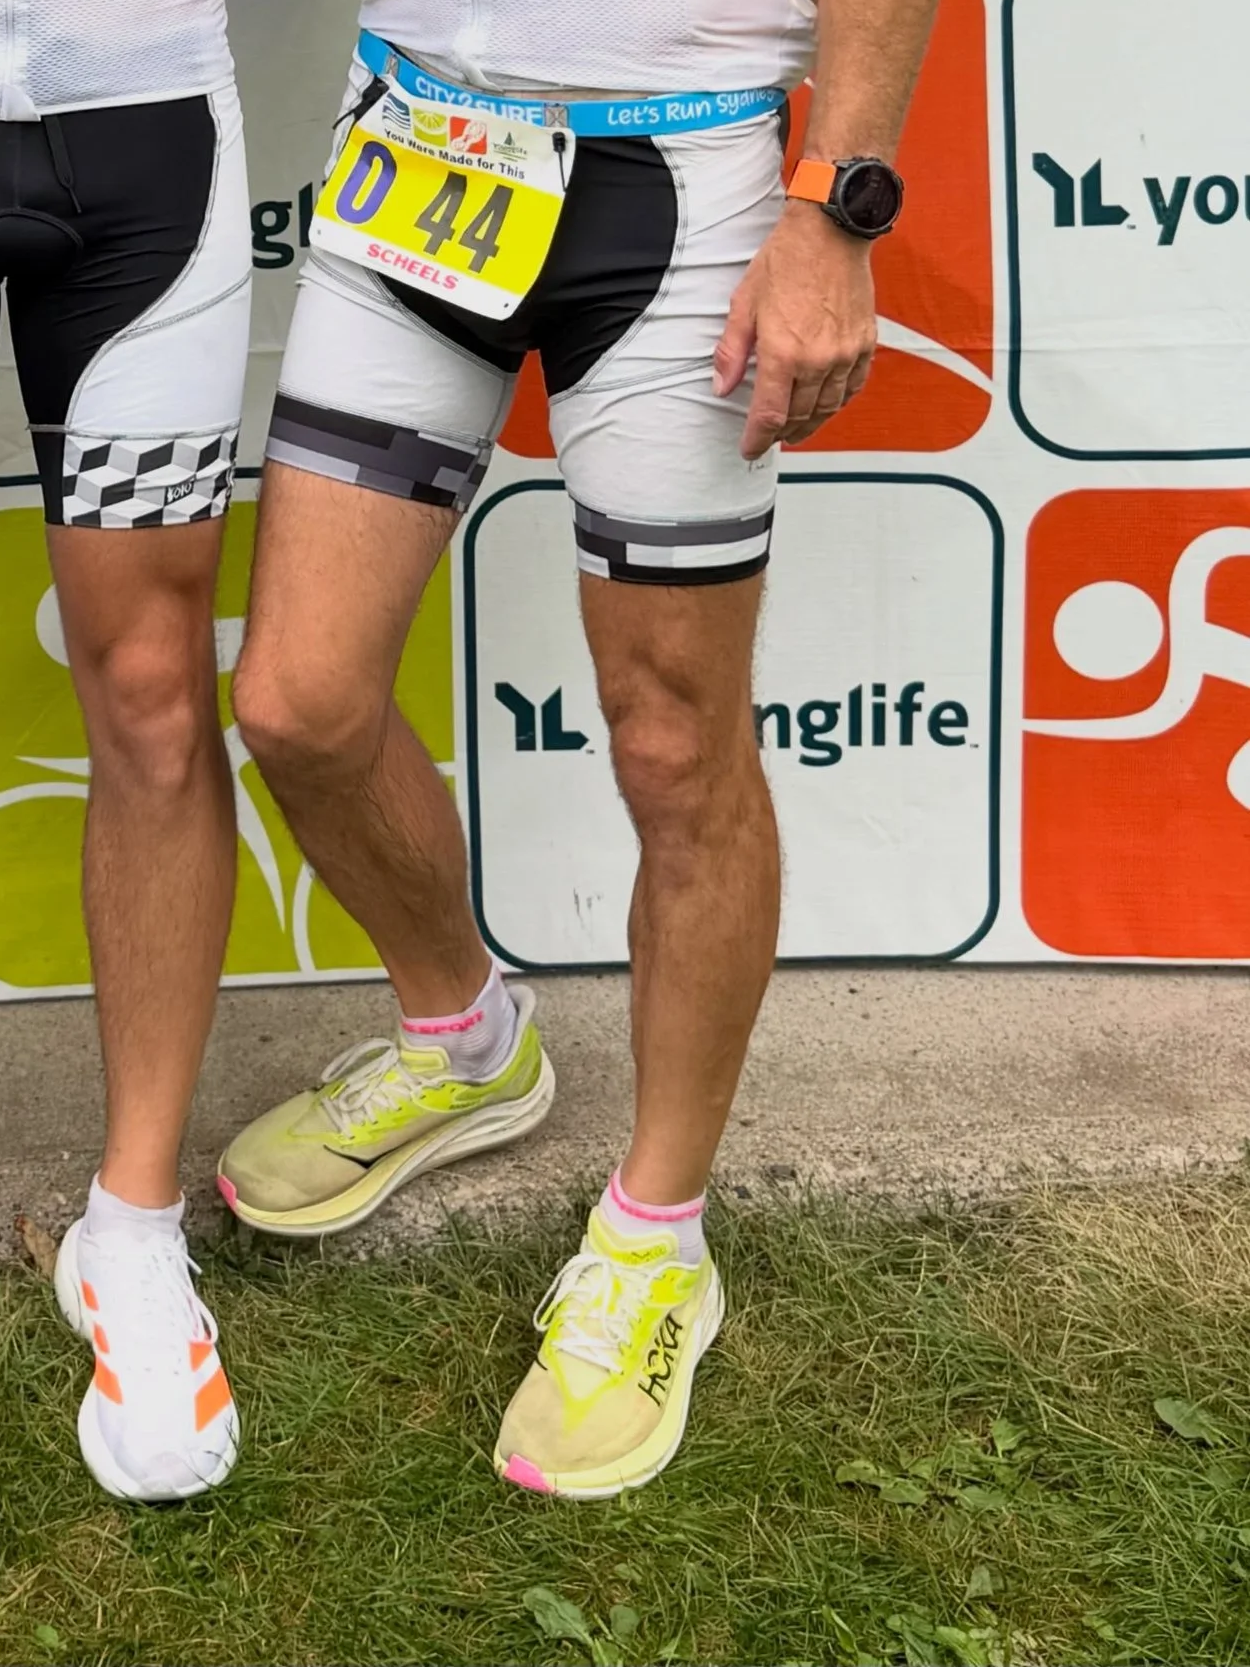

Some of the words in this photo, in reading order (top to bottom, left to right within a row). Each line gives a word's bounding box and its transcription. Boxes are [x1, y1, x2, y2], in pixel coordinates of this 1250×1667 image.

[608, 106, 660, 125] Let's
[666, 100, 712, 121] Run
[384, 128, 405, 147] You
[407, 134, 435, 155] Were
[439, 147, 473, 166] Made
[477, 156, 495, 171] for
[499, 162, 525, 180] This
[414, 171, 513, 273] 44
[1143, 175, 1250, 246] yo
[366, 243, 459, 290] SCHEELS
